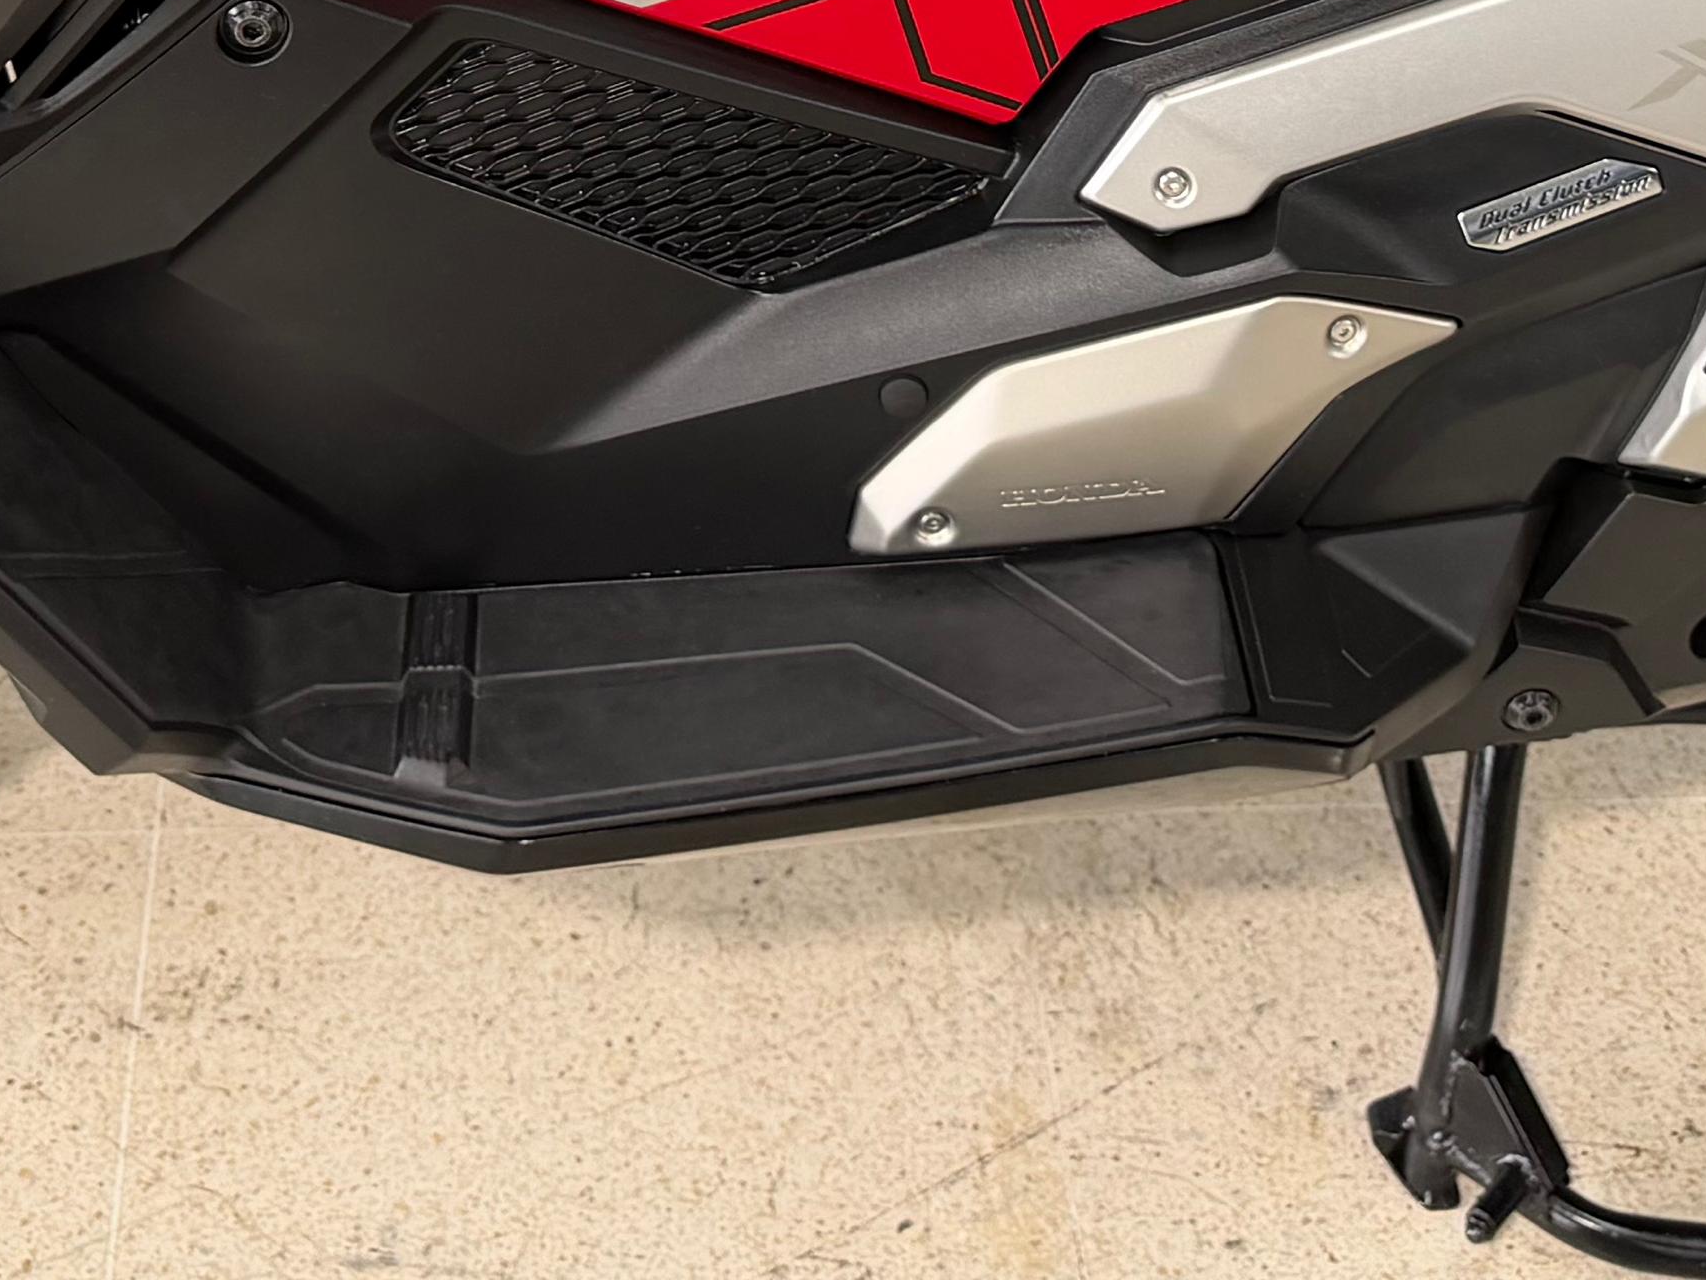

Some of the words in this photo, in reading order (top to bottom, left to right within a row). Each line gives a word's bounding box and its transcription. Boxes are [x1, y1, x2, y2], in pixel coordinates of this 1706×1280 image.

[1478, 197, 1531, 230] Dual
[1536, 169, 1612, 208] Clutch
[1493, 174, 1652, 244] Transmission
[999, 478, 1167, 509] HONDA
